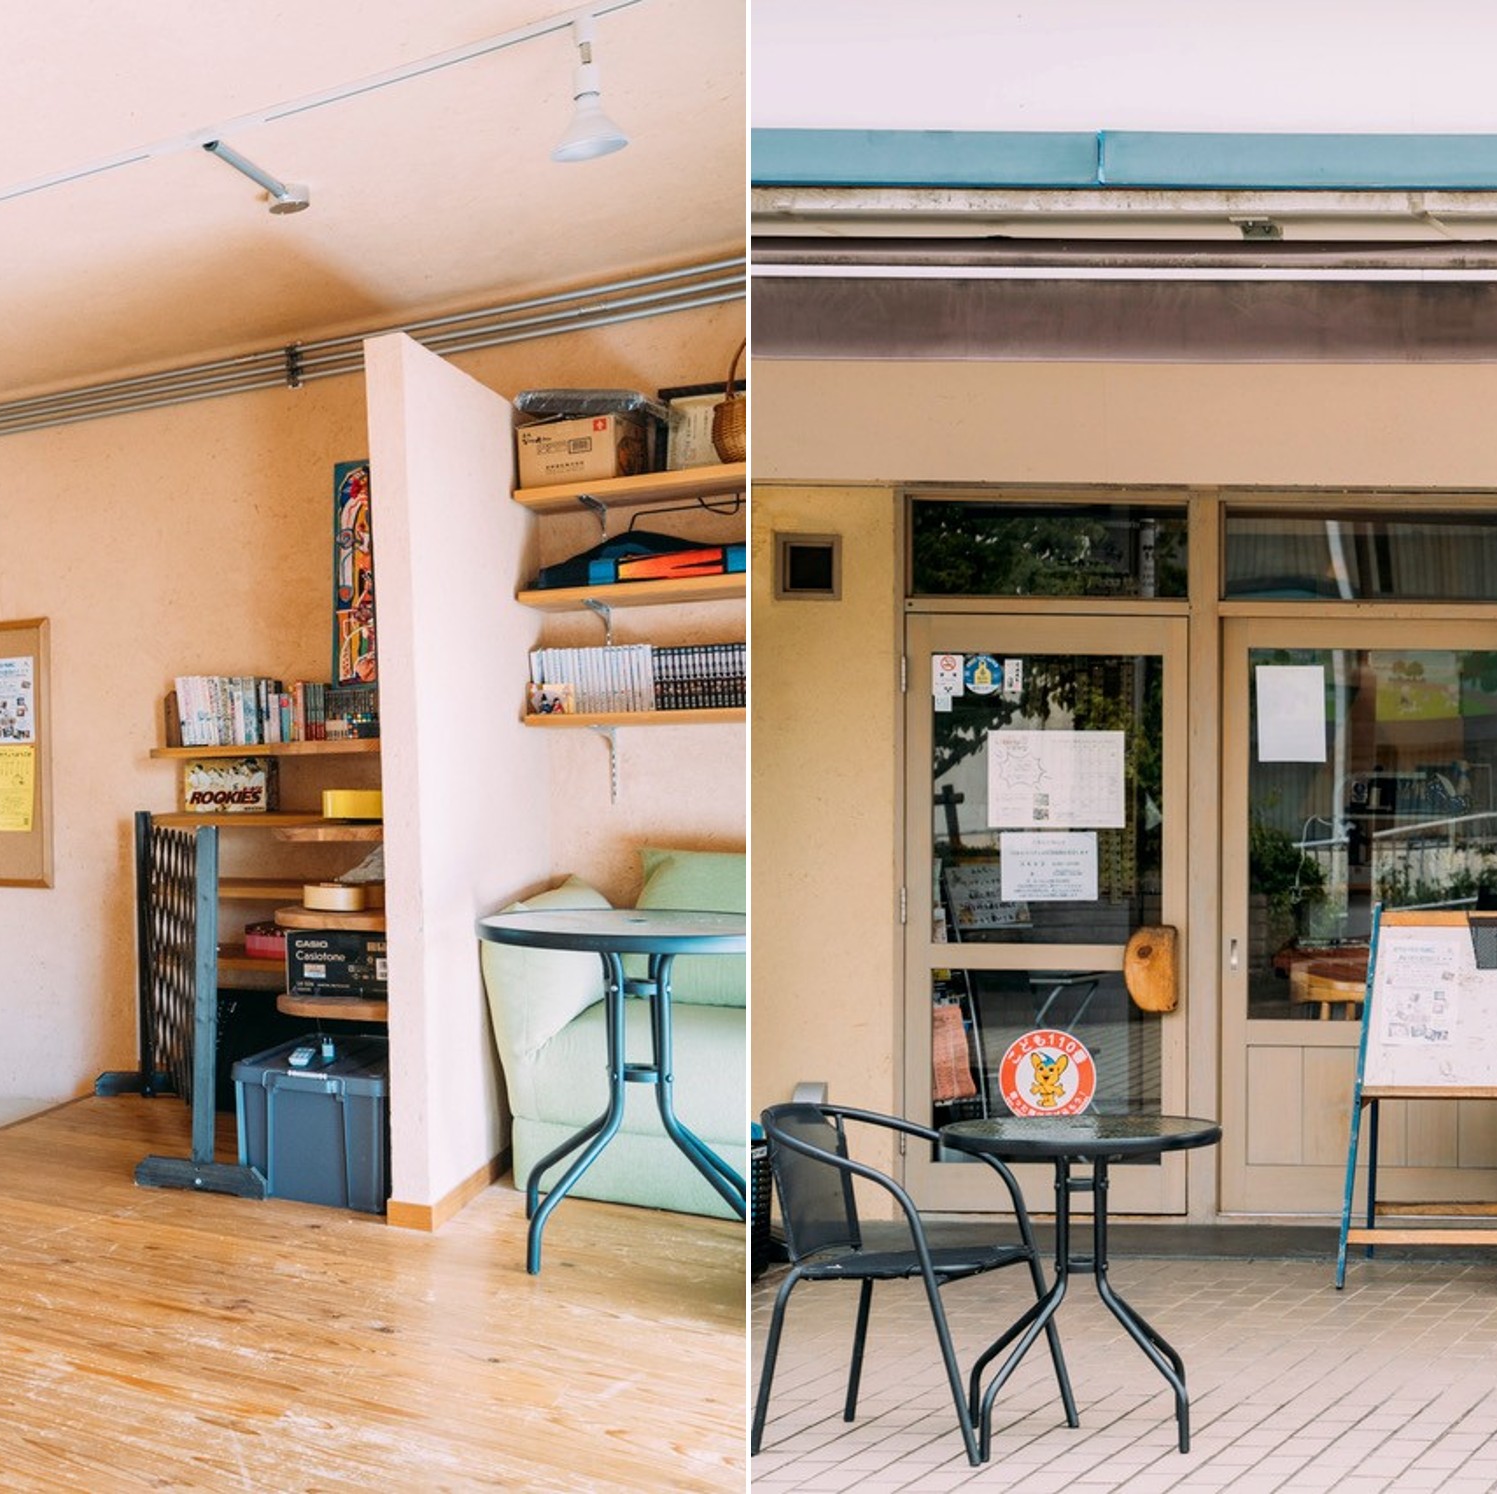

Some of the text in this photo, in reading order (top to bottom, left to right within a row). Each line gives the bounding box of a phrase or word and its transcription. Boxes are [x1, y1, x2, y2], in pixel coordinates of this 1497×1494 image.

[190, 791, 261, 805] ROOKIES
[295, 940, 328, 948] CASIO
[295, 950, 346, 962] Casiotone
[1008, 1034, 1088, 1065] こども110番
